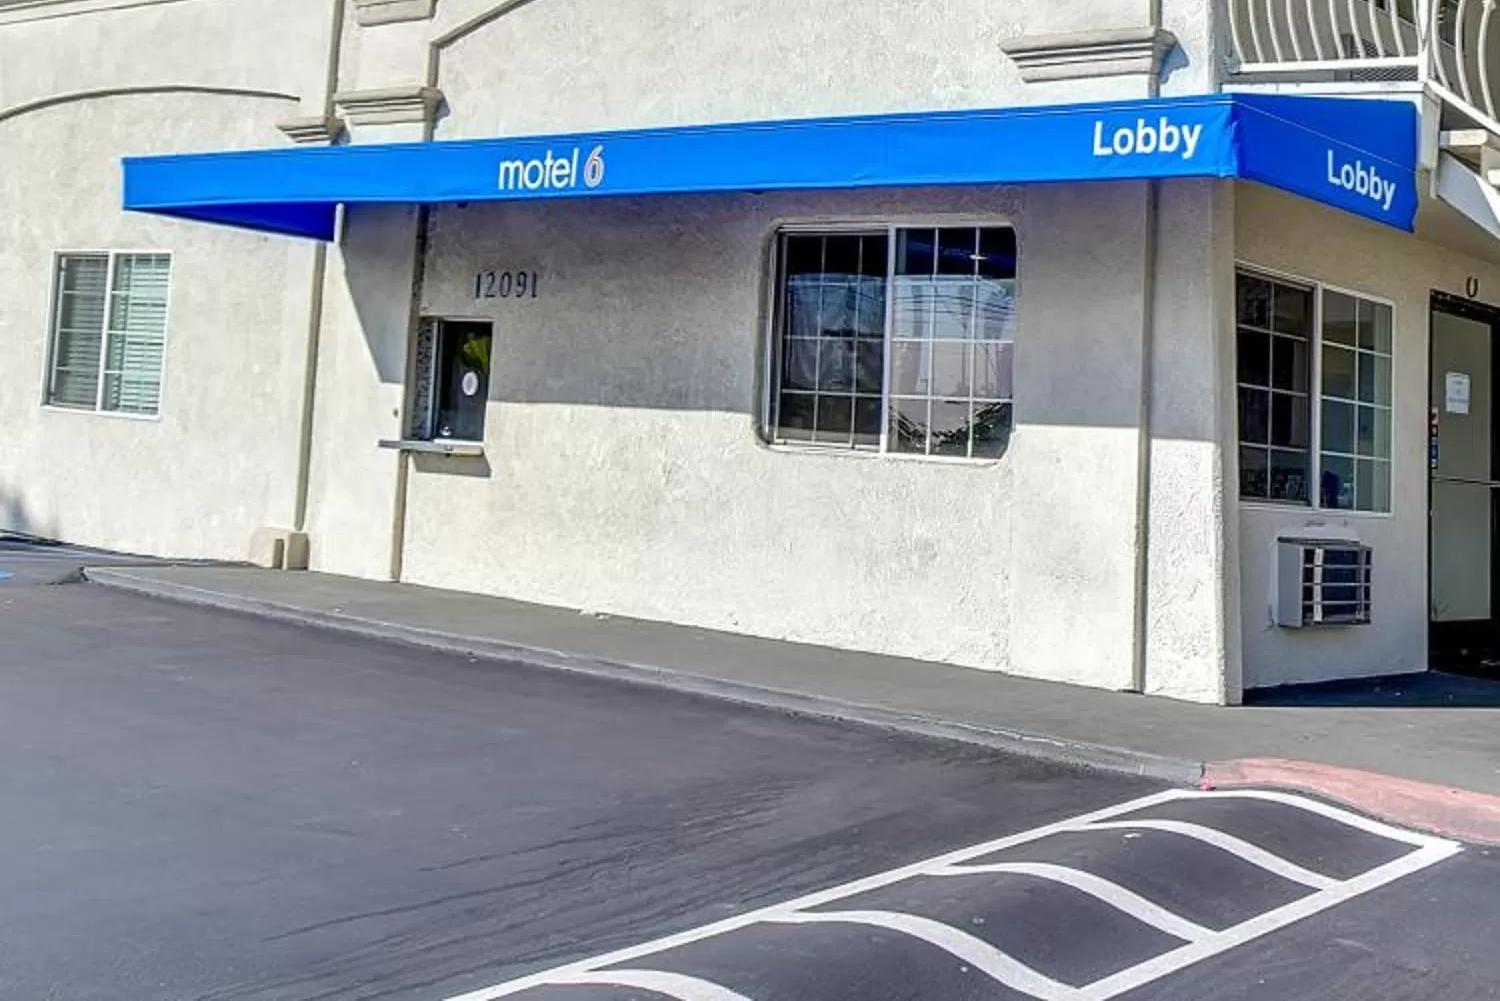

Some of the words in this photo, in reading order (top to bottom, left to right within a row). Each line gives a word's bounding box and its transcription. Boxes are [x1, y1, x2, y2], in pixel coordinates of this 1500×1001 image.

[1092, 117, 1202, 158] Lobby
[498, 147, 580, 190] motel
[583, 144, 605, 188] 6
[1327, 149, 1396, 210] Lobby
[476, 270, 537, 298] 12091
